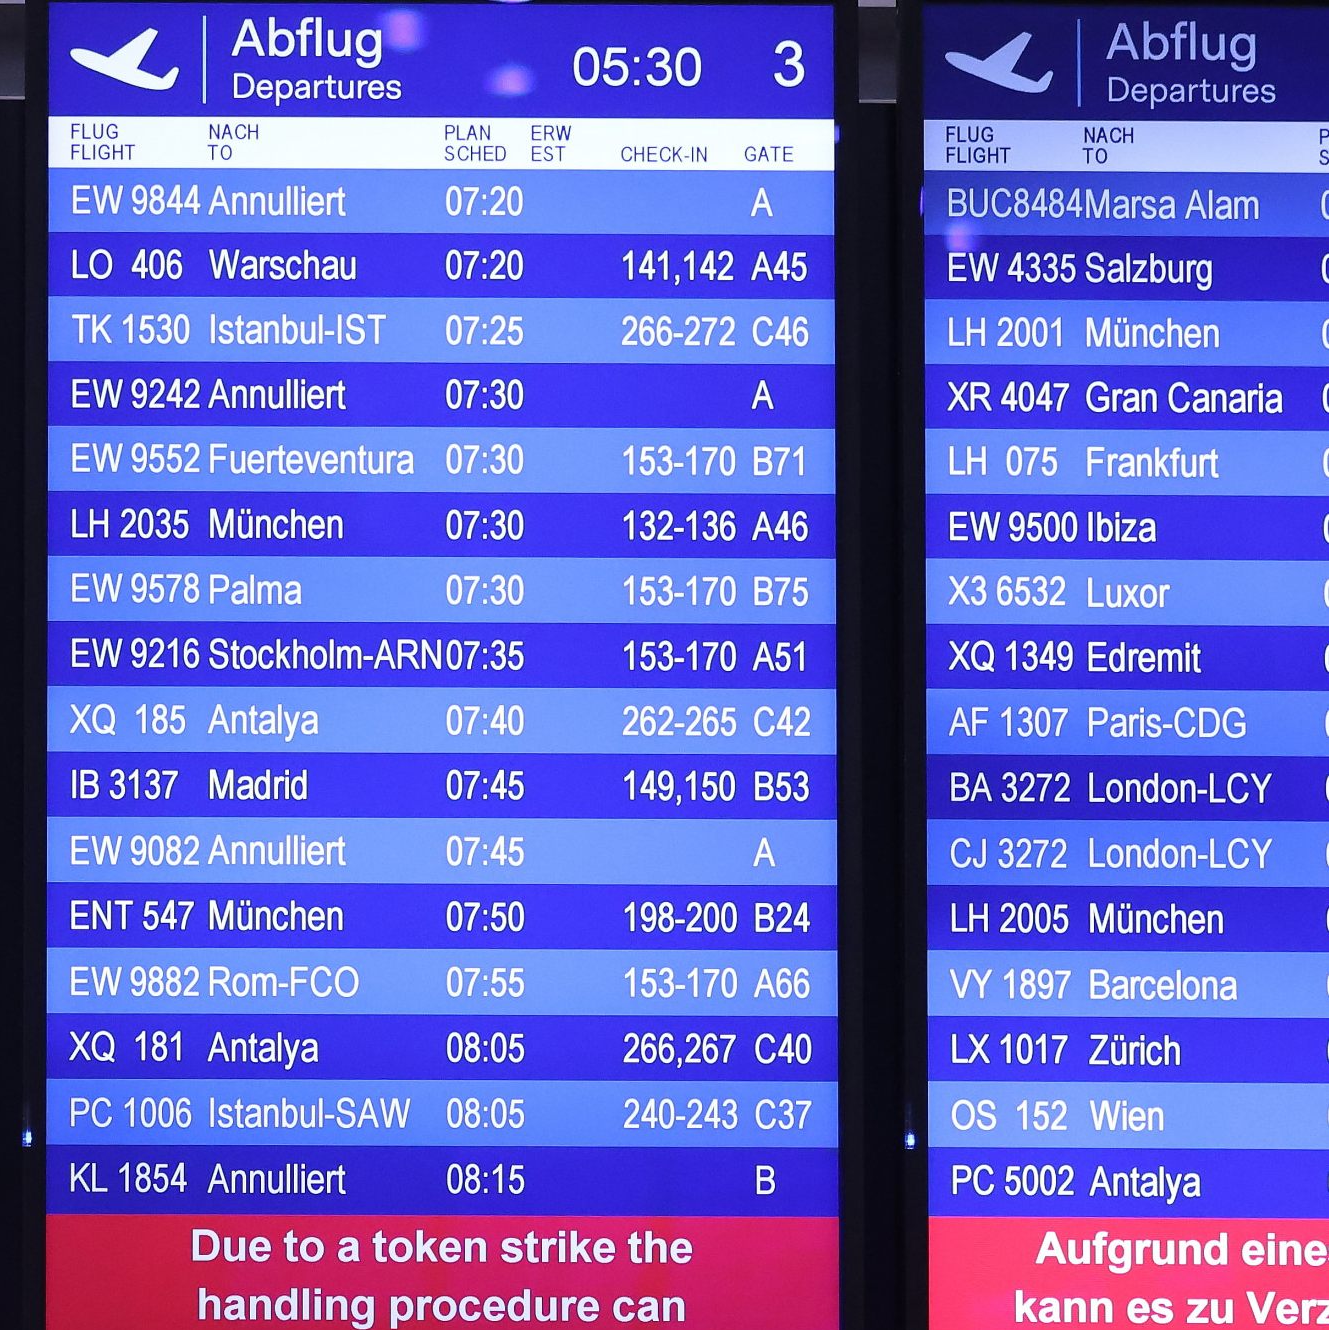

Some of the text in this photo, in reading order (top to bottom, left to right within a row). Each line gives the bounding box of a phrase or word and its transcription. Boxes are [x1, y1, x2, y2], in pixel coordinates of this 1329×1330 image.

[232, 17, 381, 68] Abflug
[1106, 21, 1255, 72] Abflug
[574, 40, 804, 87] 05:30 3
[234, 72, 401, 106] Departures
[1109, 77, 1275, 109] Departures
[71, 124, 571, 141] FLUG NACH PLAN ERW
[946, 126, 1133, 143] FLUG NACH
[71, 144, 793, 162] FLIGHT TO SCHED EST CHECK-IN GATE
[947, 147, 1107, 164] FLIGHT TO
[72, 314, 808, 346] TK 1530 Istanbul-IST 07:25 266-272 C46
[948, 381, 1282, 413] XR 4047 Gran Canaria
[951, 772, 1272, 803] BA 3272 London-LCY
[71, 900, 810, 932] ENT 547 München 07:50 198-200 B24
[950, 969, 1237, 1000] VY 1897 Barcelona
[71, 1097, 811, 1129] PC 1006 Istanbul-SAW 08:05 240-243 C37
[952, 1100, 1163, 1131] OS 152 Wien
[193, 1229, 692, 1263] Due to a token strike the
[1036, 1231, 1329, 1274] Aufgrund eine
[199, 1288, 684, 1329] handling procedure can
[1016, 1290, 1112, 1323] kann
[1127, 1298, 1173, 1324] es
[1187, 1299, 1233, 1324] zu
